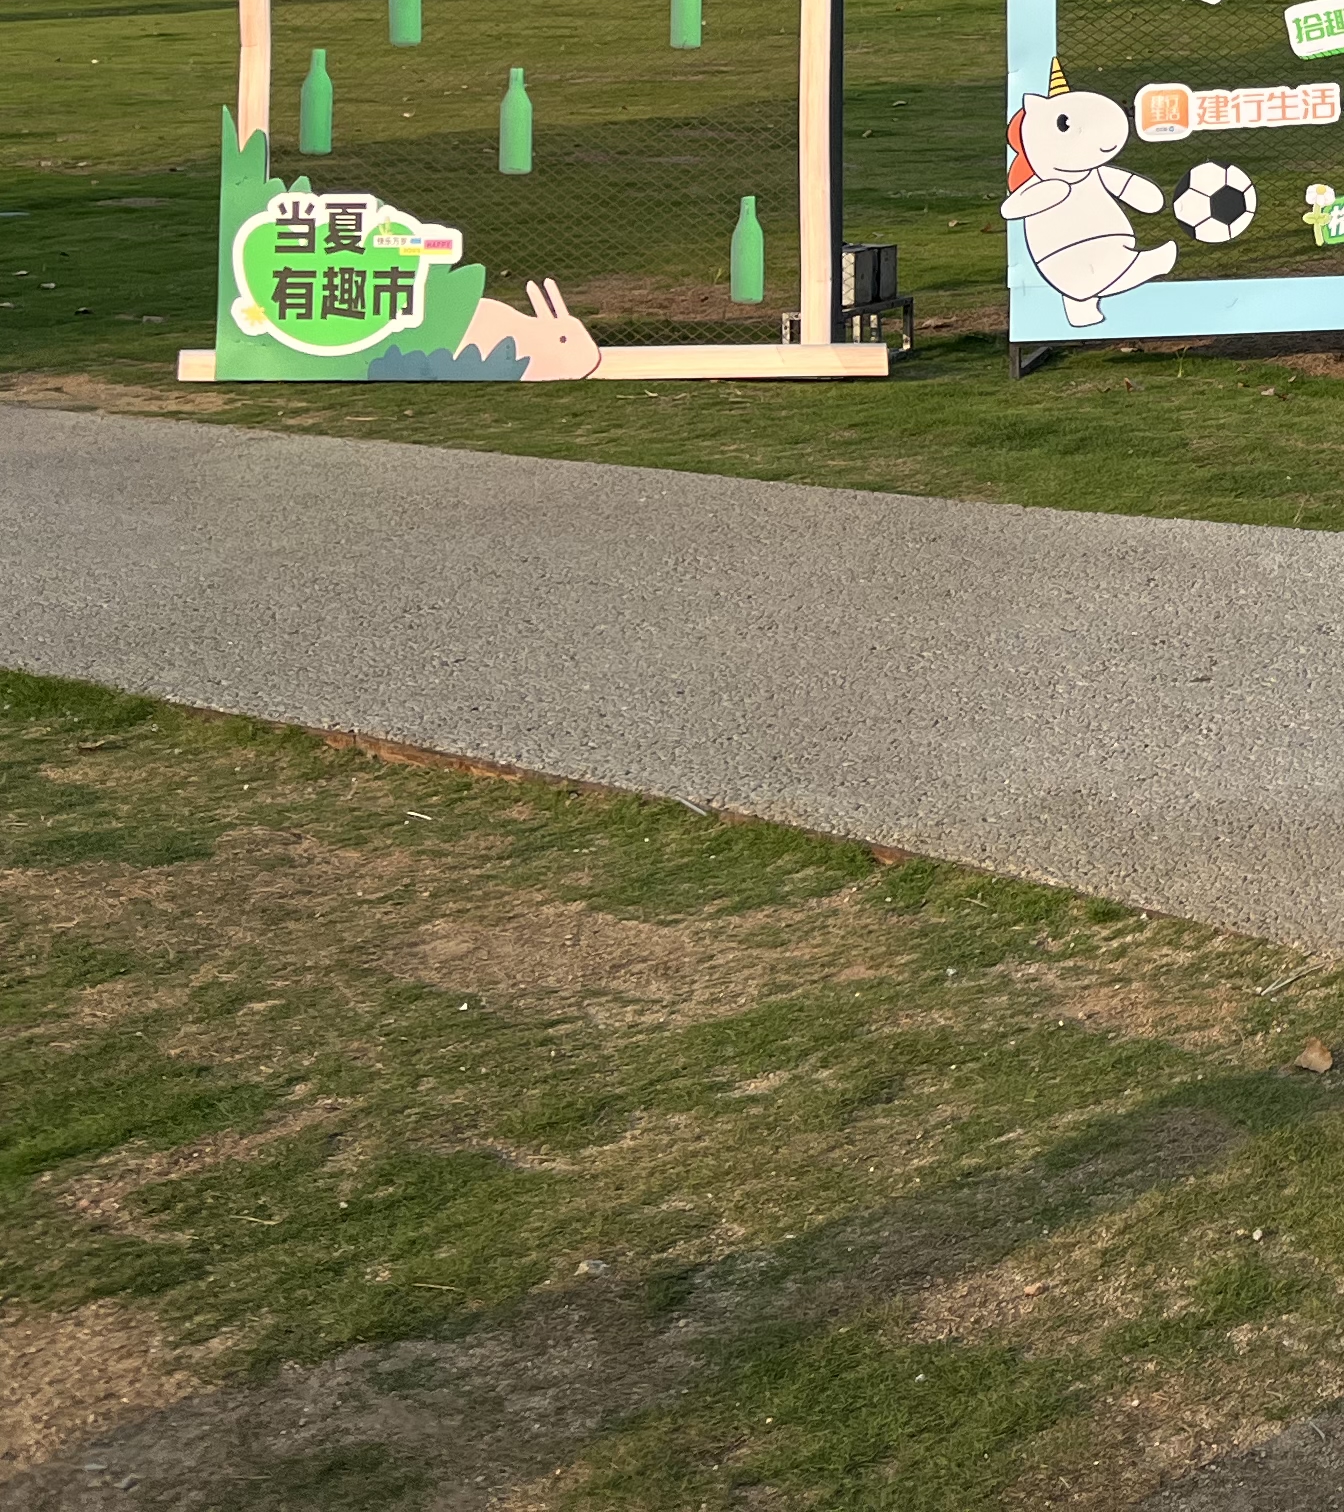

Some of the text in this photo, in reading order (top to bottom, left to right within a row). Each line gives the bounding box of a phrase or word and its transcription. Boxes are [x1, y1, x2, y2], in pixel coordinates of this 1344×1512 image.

[1196, 88, 1335, 125] 建行生活
[275, 201, 367, 255] 当夏
[271, 266, 416, 320] 有趣市
